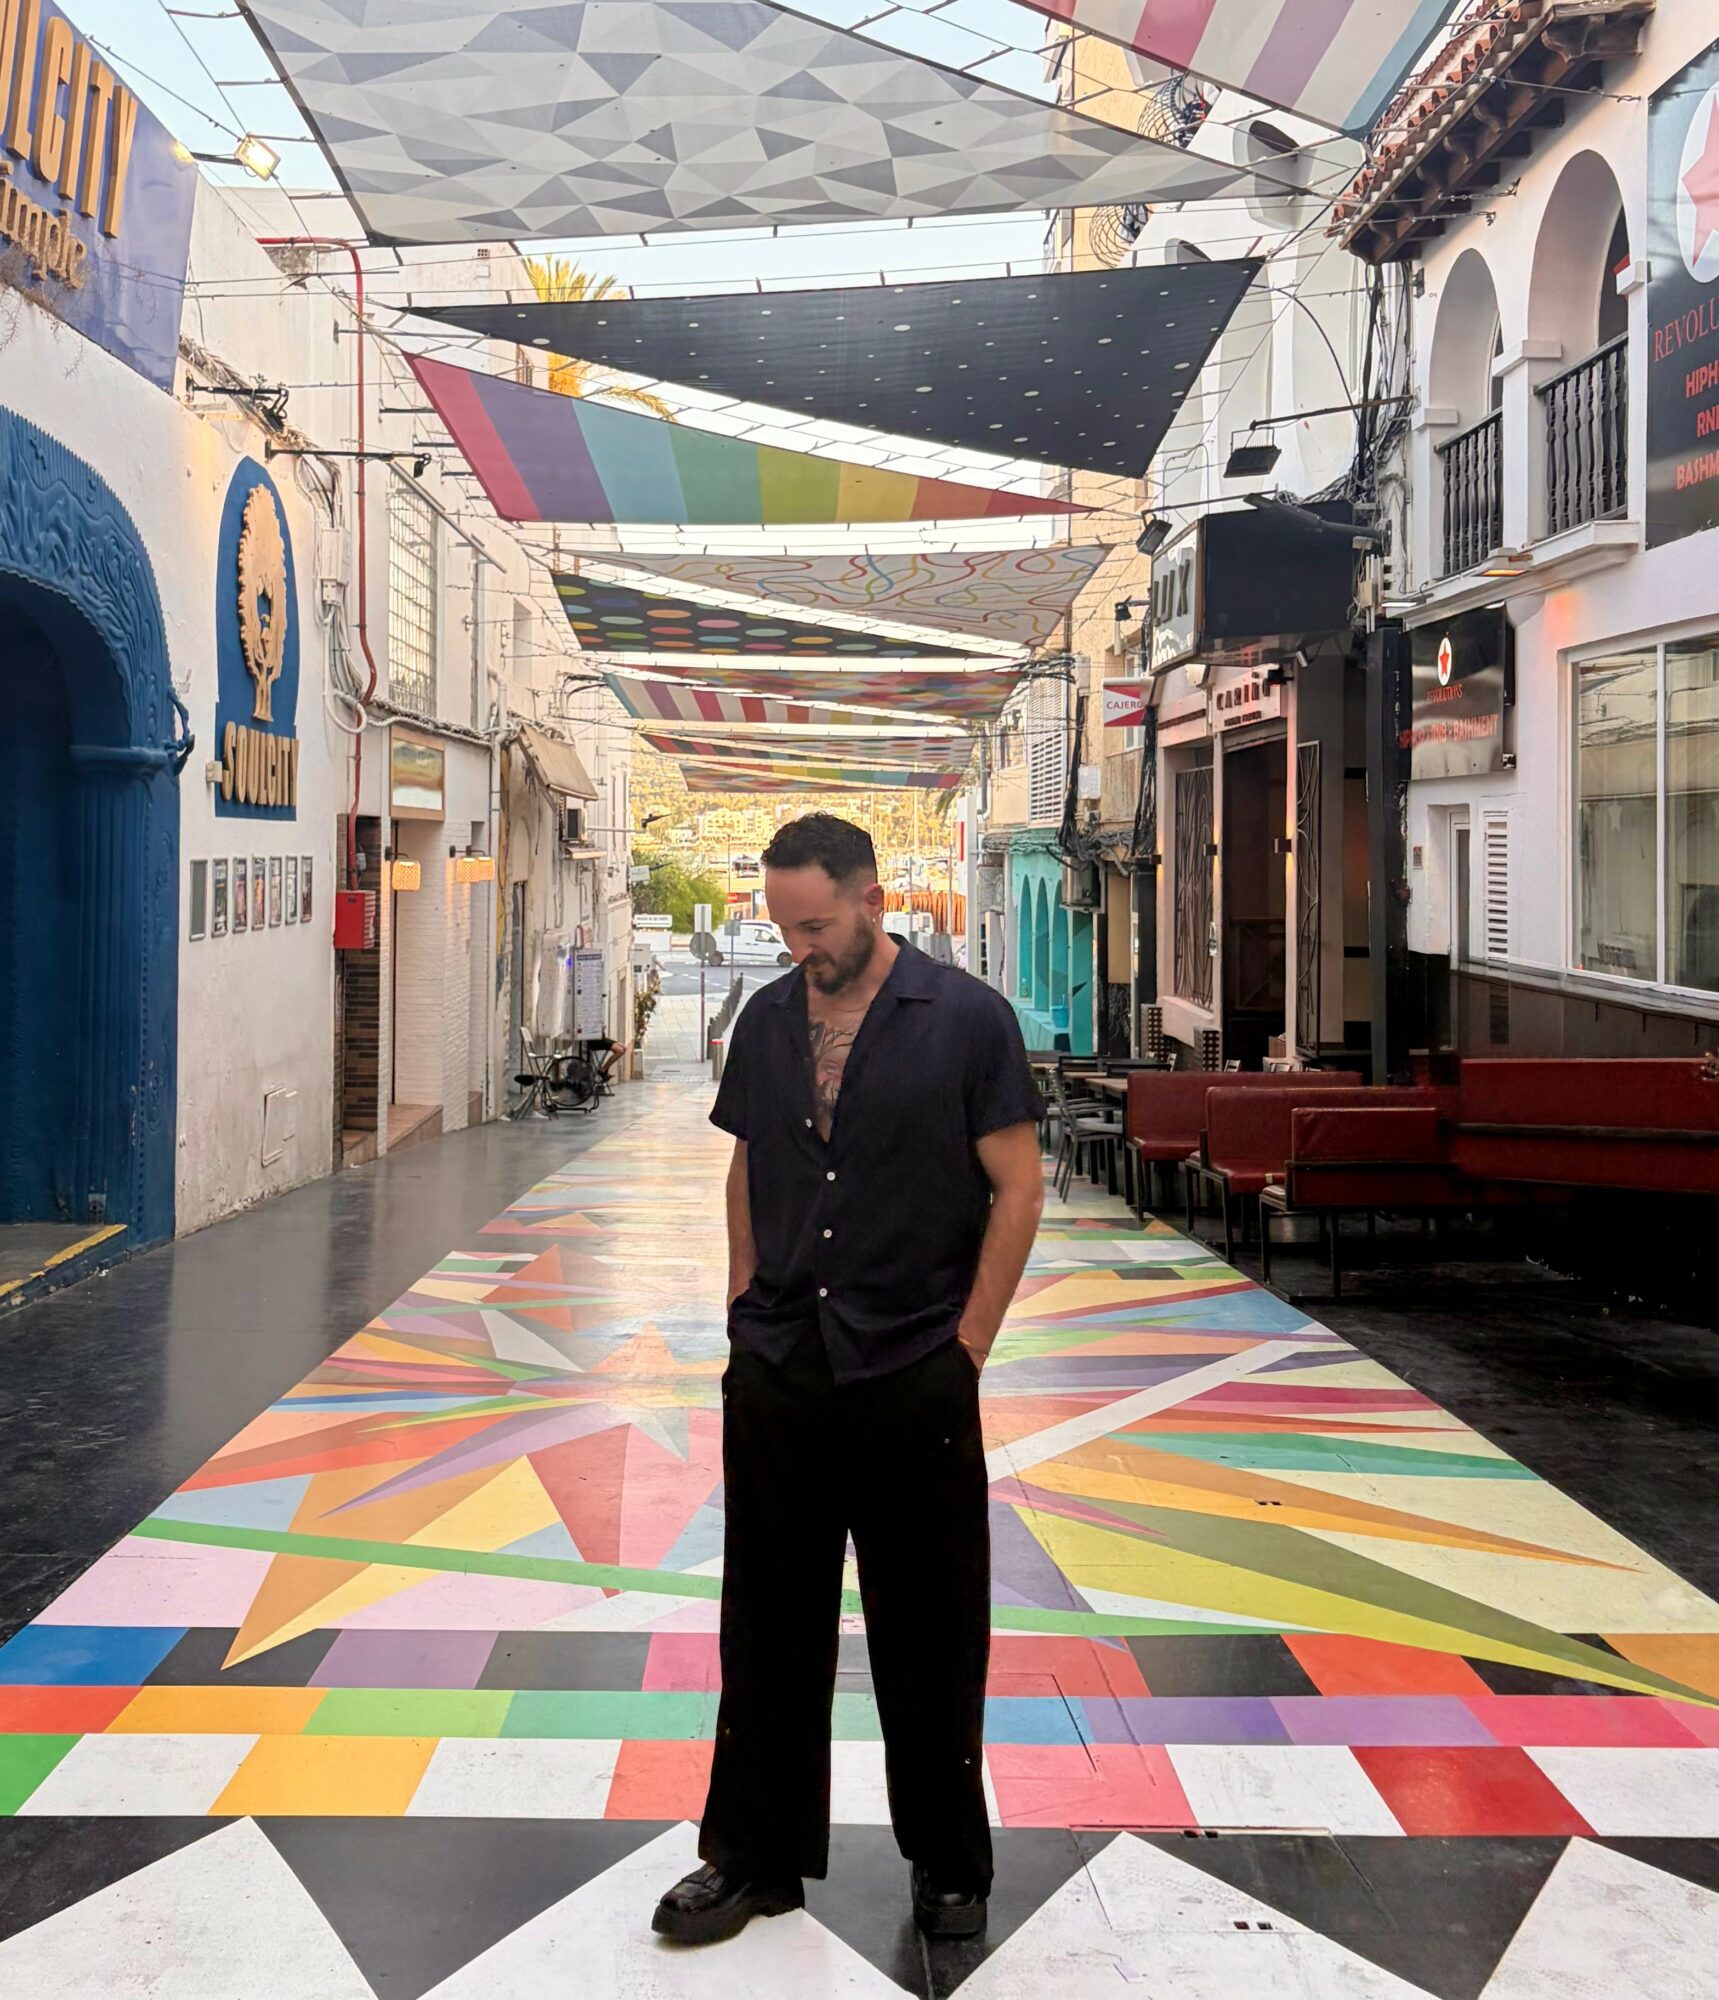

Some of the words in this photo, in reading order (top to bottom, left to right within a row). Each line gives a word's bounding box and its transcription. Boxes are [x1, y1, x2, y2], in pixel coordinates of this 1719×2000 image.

[1685, 361, 1719, 399] HIPH
[1153, 559, 1190, 627] LUX
[1106, 700, 1145, 710] CAJERO
[222, 721, 299, 807] SOULCITY
